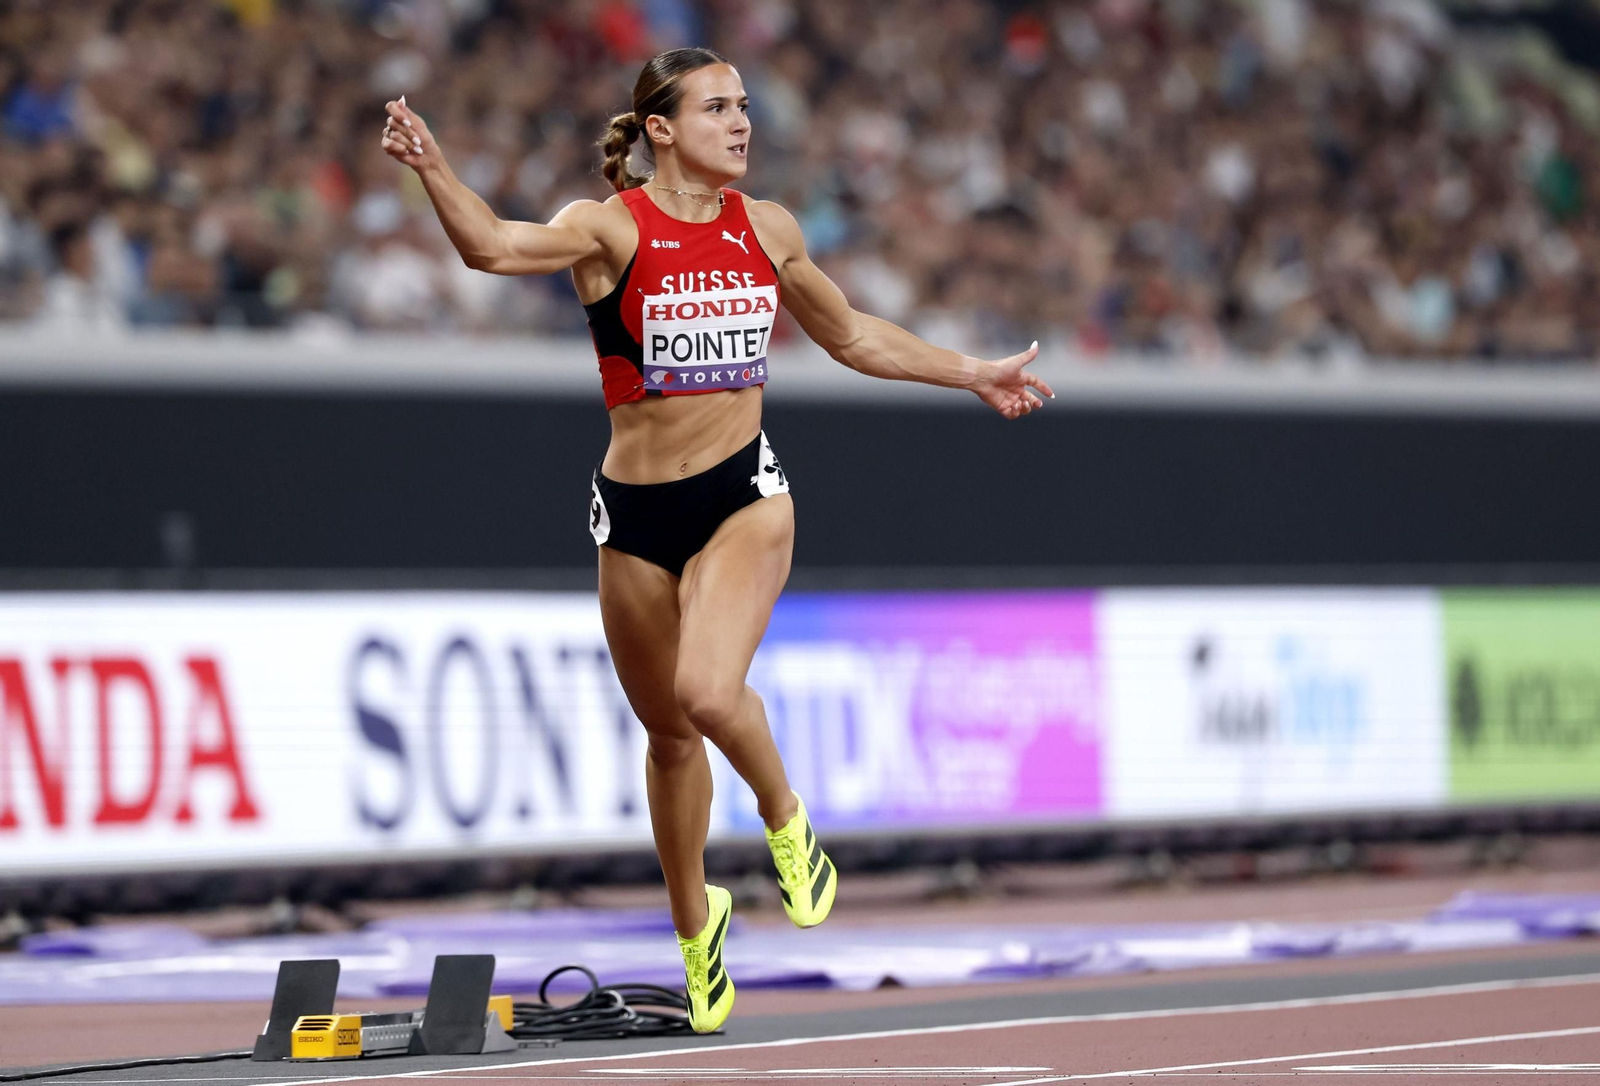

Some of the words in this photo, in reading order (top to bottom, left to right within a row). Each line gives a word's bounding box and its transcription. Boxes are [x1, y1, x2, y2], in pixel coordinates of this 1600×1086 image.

[661, 240, 680, 249] UBS
[646, 296, 774, 321] HONDA
[652, 326, 769, 362] POINTET
[338, 1028, 360, 1046] SEIKO
